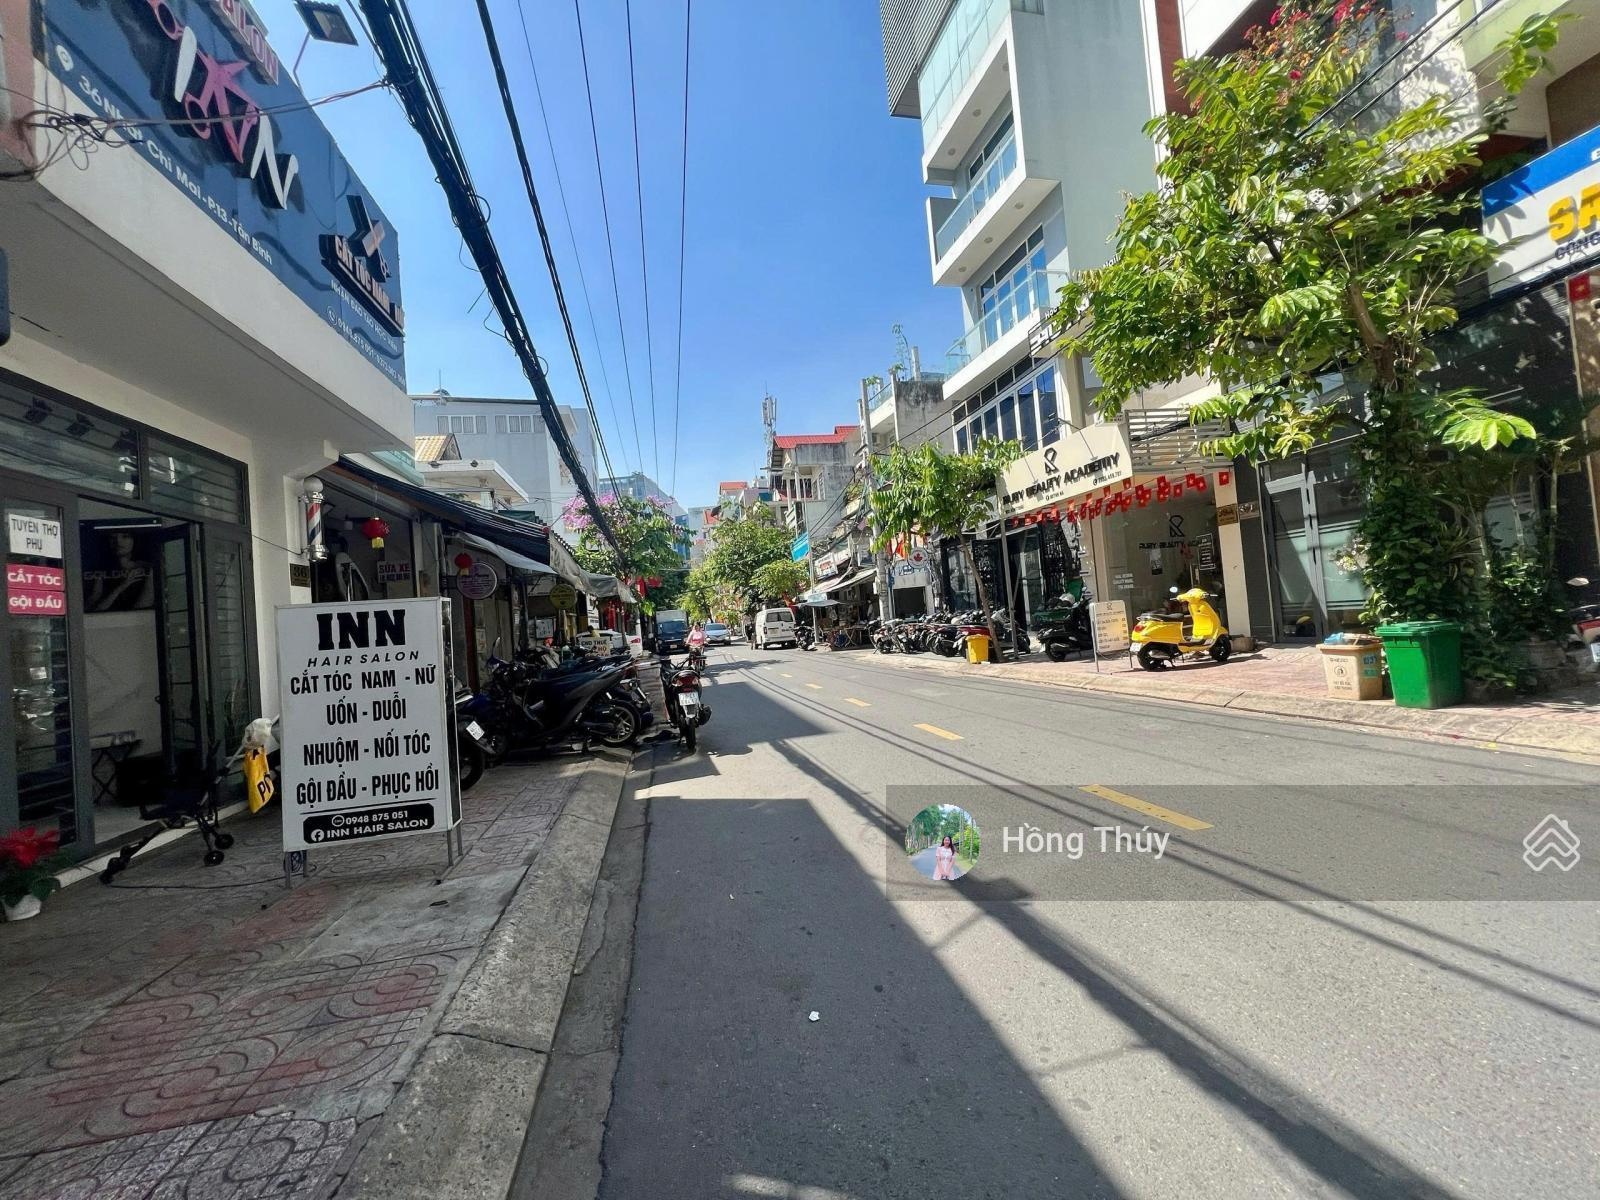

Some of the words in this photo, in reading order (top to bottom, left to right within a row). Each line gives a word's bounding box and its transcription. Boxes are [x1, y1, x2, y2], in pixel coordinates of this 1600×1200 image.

[78, 75, 103, 105] 36
[147, 140, 173, 172] Chi
[176, 164, 202, 196] Mai
[252, 237, 273, 266] Bình
[316, 609, 406, 650] INN
[307, 655, 353, 667] HAIR
[360, 650, 419, 664] SALON
[290, 669, 319, 695] CẮT
[323, 669, 352, 692] TÓC
[361, 669, 396, 689] NAM
[414, 663, 436, 685] NỮ
[326, 696, 358, 726] UỐN
[372, 691, 407, 722] DUỖI
[303, 737, 359, 768] NHUỘM
[374, 728, 399, 759] NỐI
[403, 729, 431, 756] TÓC
[296, 777, 322, 808] GỘI
[326, 771, 357, 801] ĐẦU
[372, 772, 411, 799] PHỤC
[415, 763, 439, 792] HỒI
[326, 828, 350, 839] INN
[353, 823, 384, 835] HAIR
[387, 818, 429, 831] SALON
[345, 816, 369, 825] 0948
[372, 811, 390, 821] 875
[391, 810, 408, 819] 051
